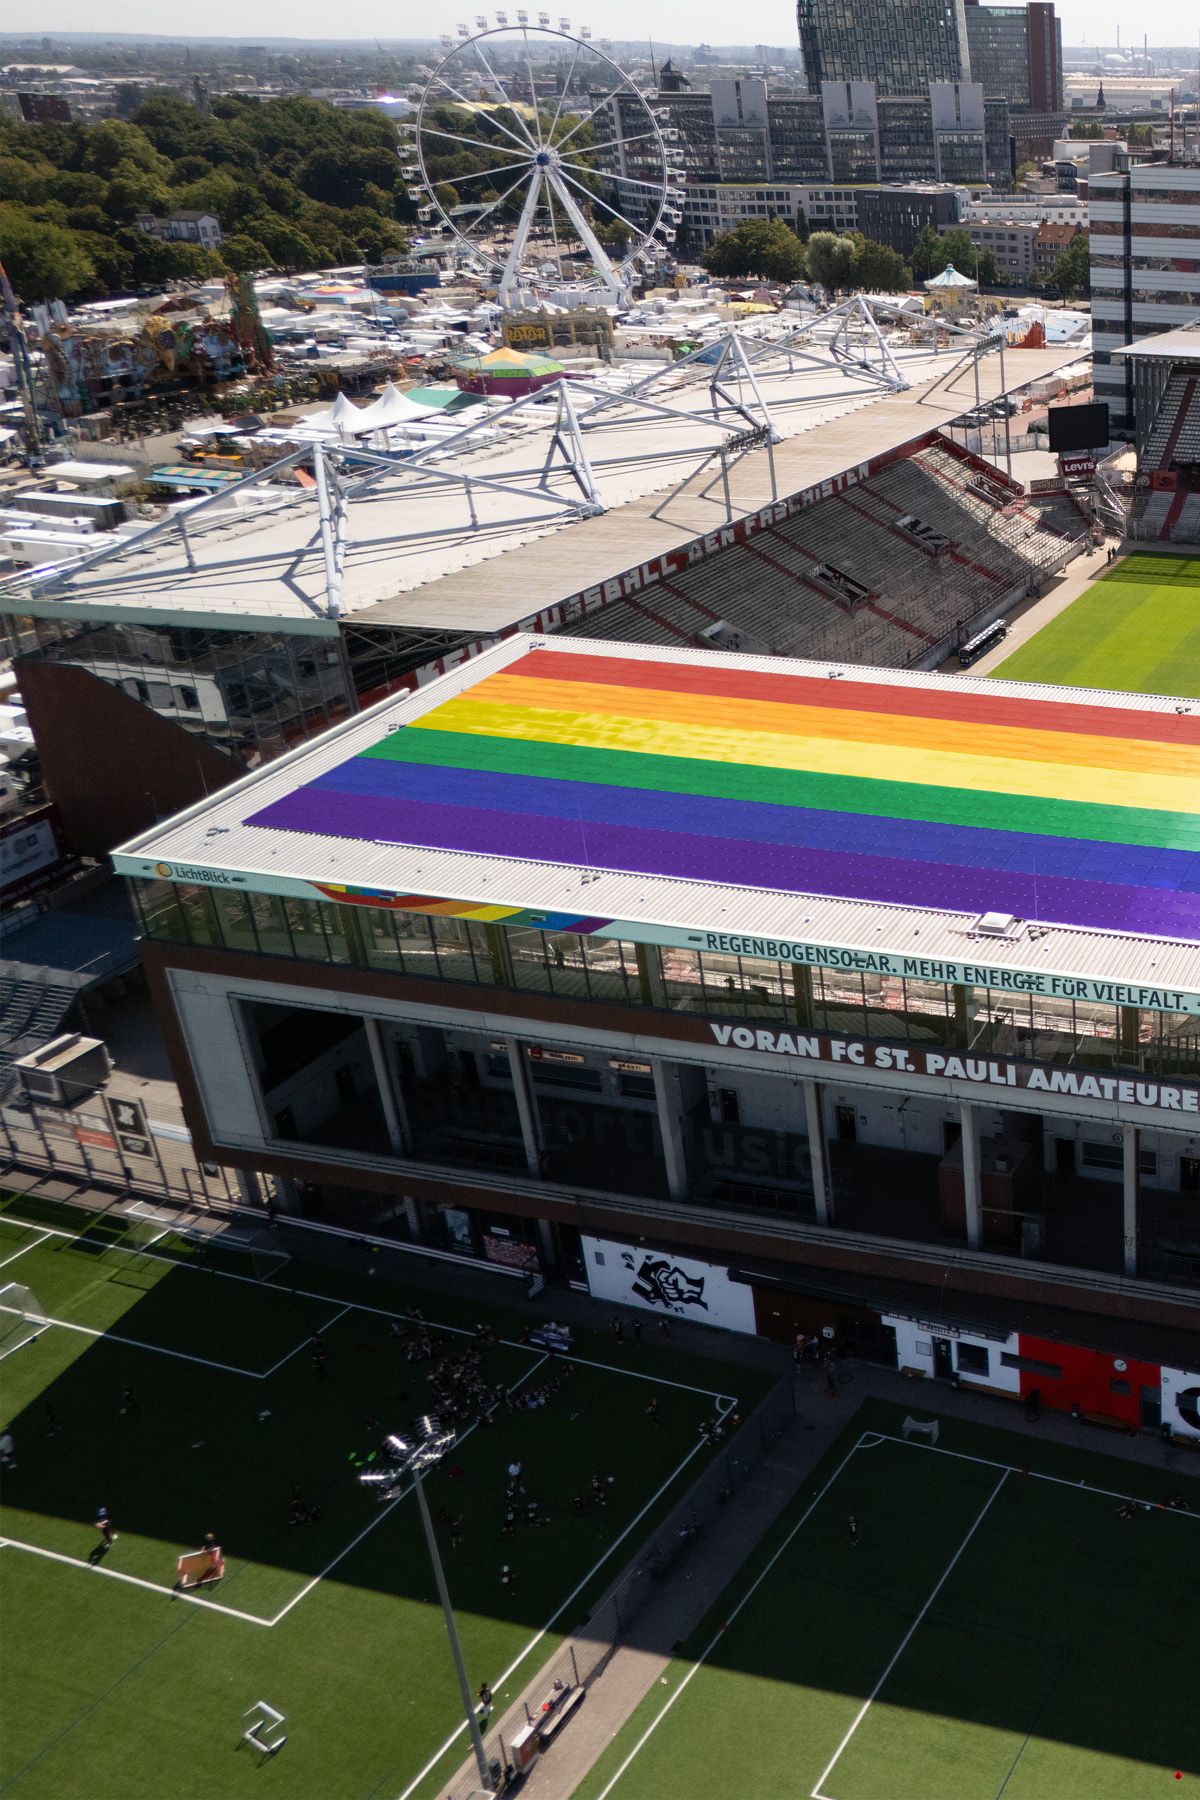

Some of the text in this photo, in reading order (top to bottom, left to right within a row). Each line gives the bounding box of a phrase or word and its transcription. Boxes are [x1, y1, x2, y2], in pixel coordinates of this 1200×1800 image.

[507, 326, 544, 341] ROTOR
[174, 865, 231, 884] LichtBlick
[706, 933, 1189, 1012] REGENBOGENSOLAR. MEHR ENERGIE FÜR VIELFALT.
[709, 1023, 1199, 1112] VORAN FC ST. PAULI AMATEURE
